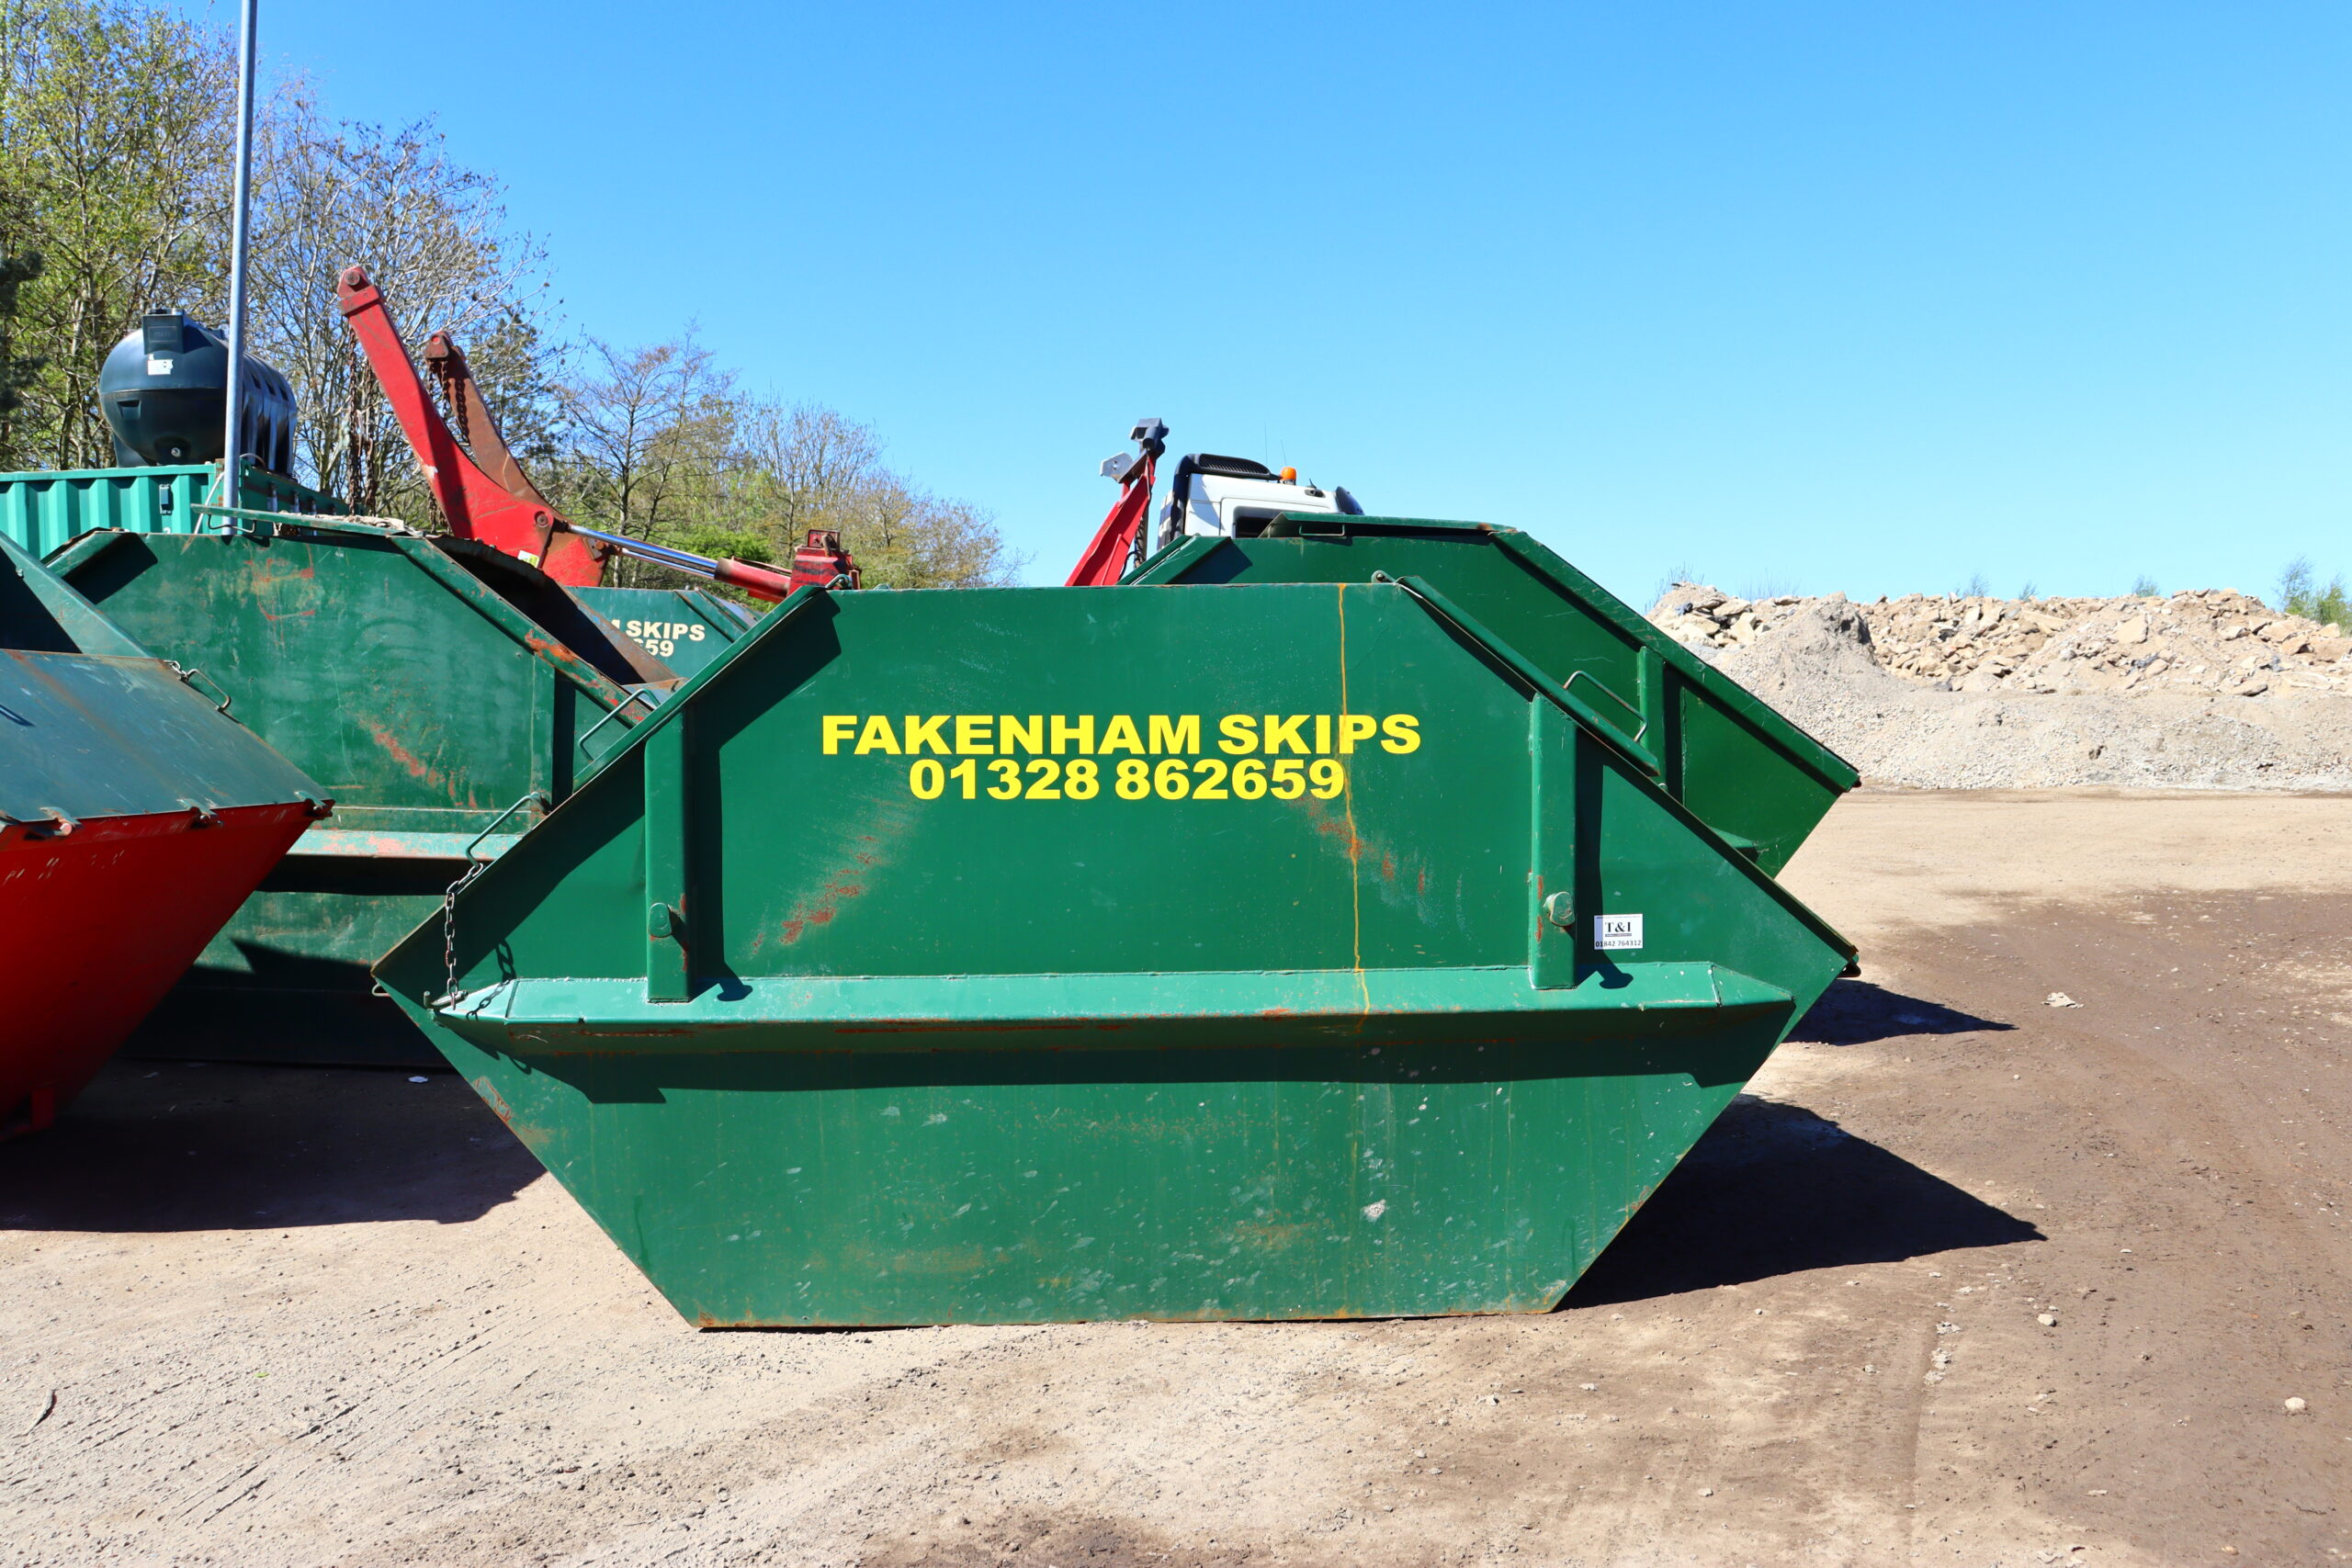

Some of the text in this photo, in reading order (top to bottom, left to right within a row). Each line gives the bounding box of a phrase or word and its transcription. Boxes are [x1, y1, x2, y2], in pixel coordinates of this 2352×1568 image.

[626, 619, 706, 641] SKIPS
[822, 714, 1421, 755] FAKENHAM SKIPS
[910, 759, 1344, 800] 01328 862659
